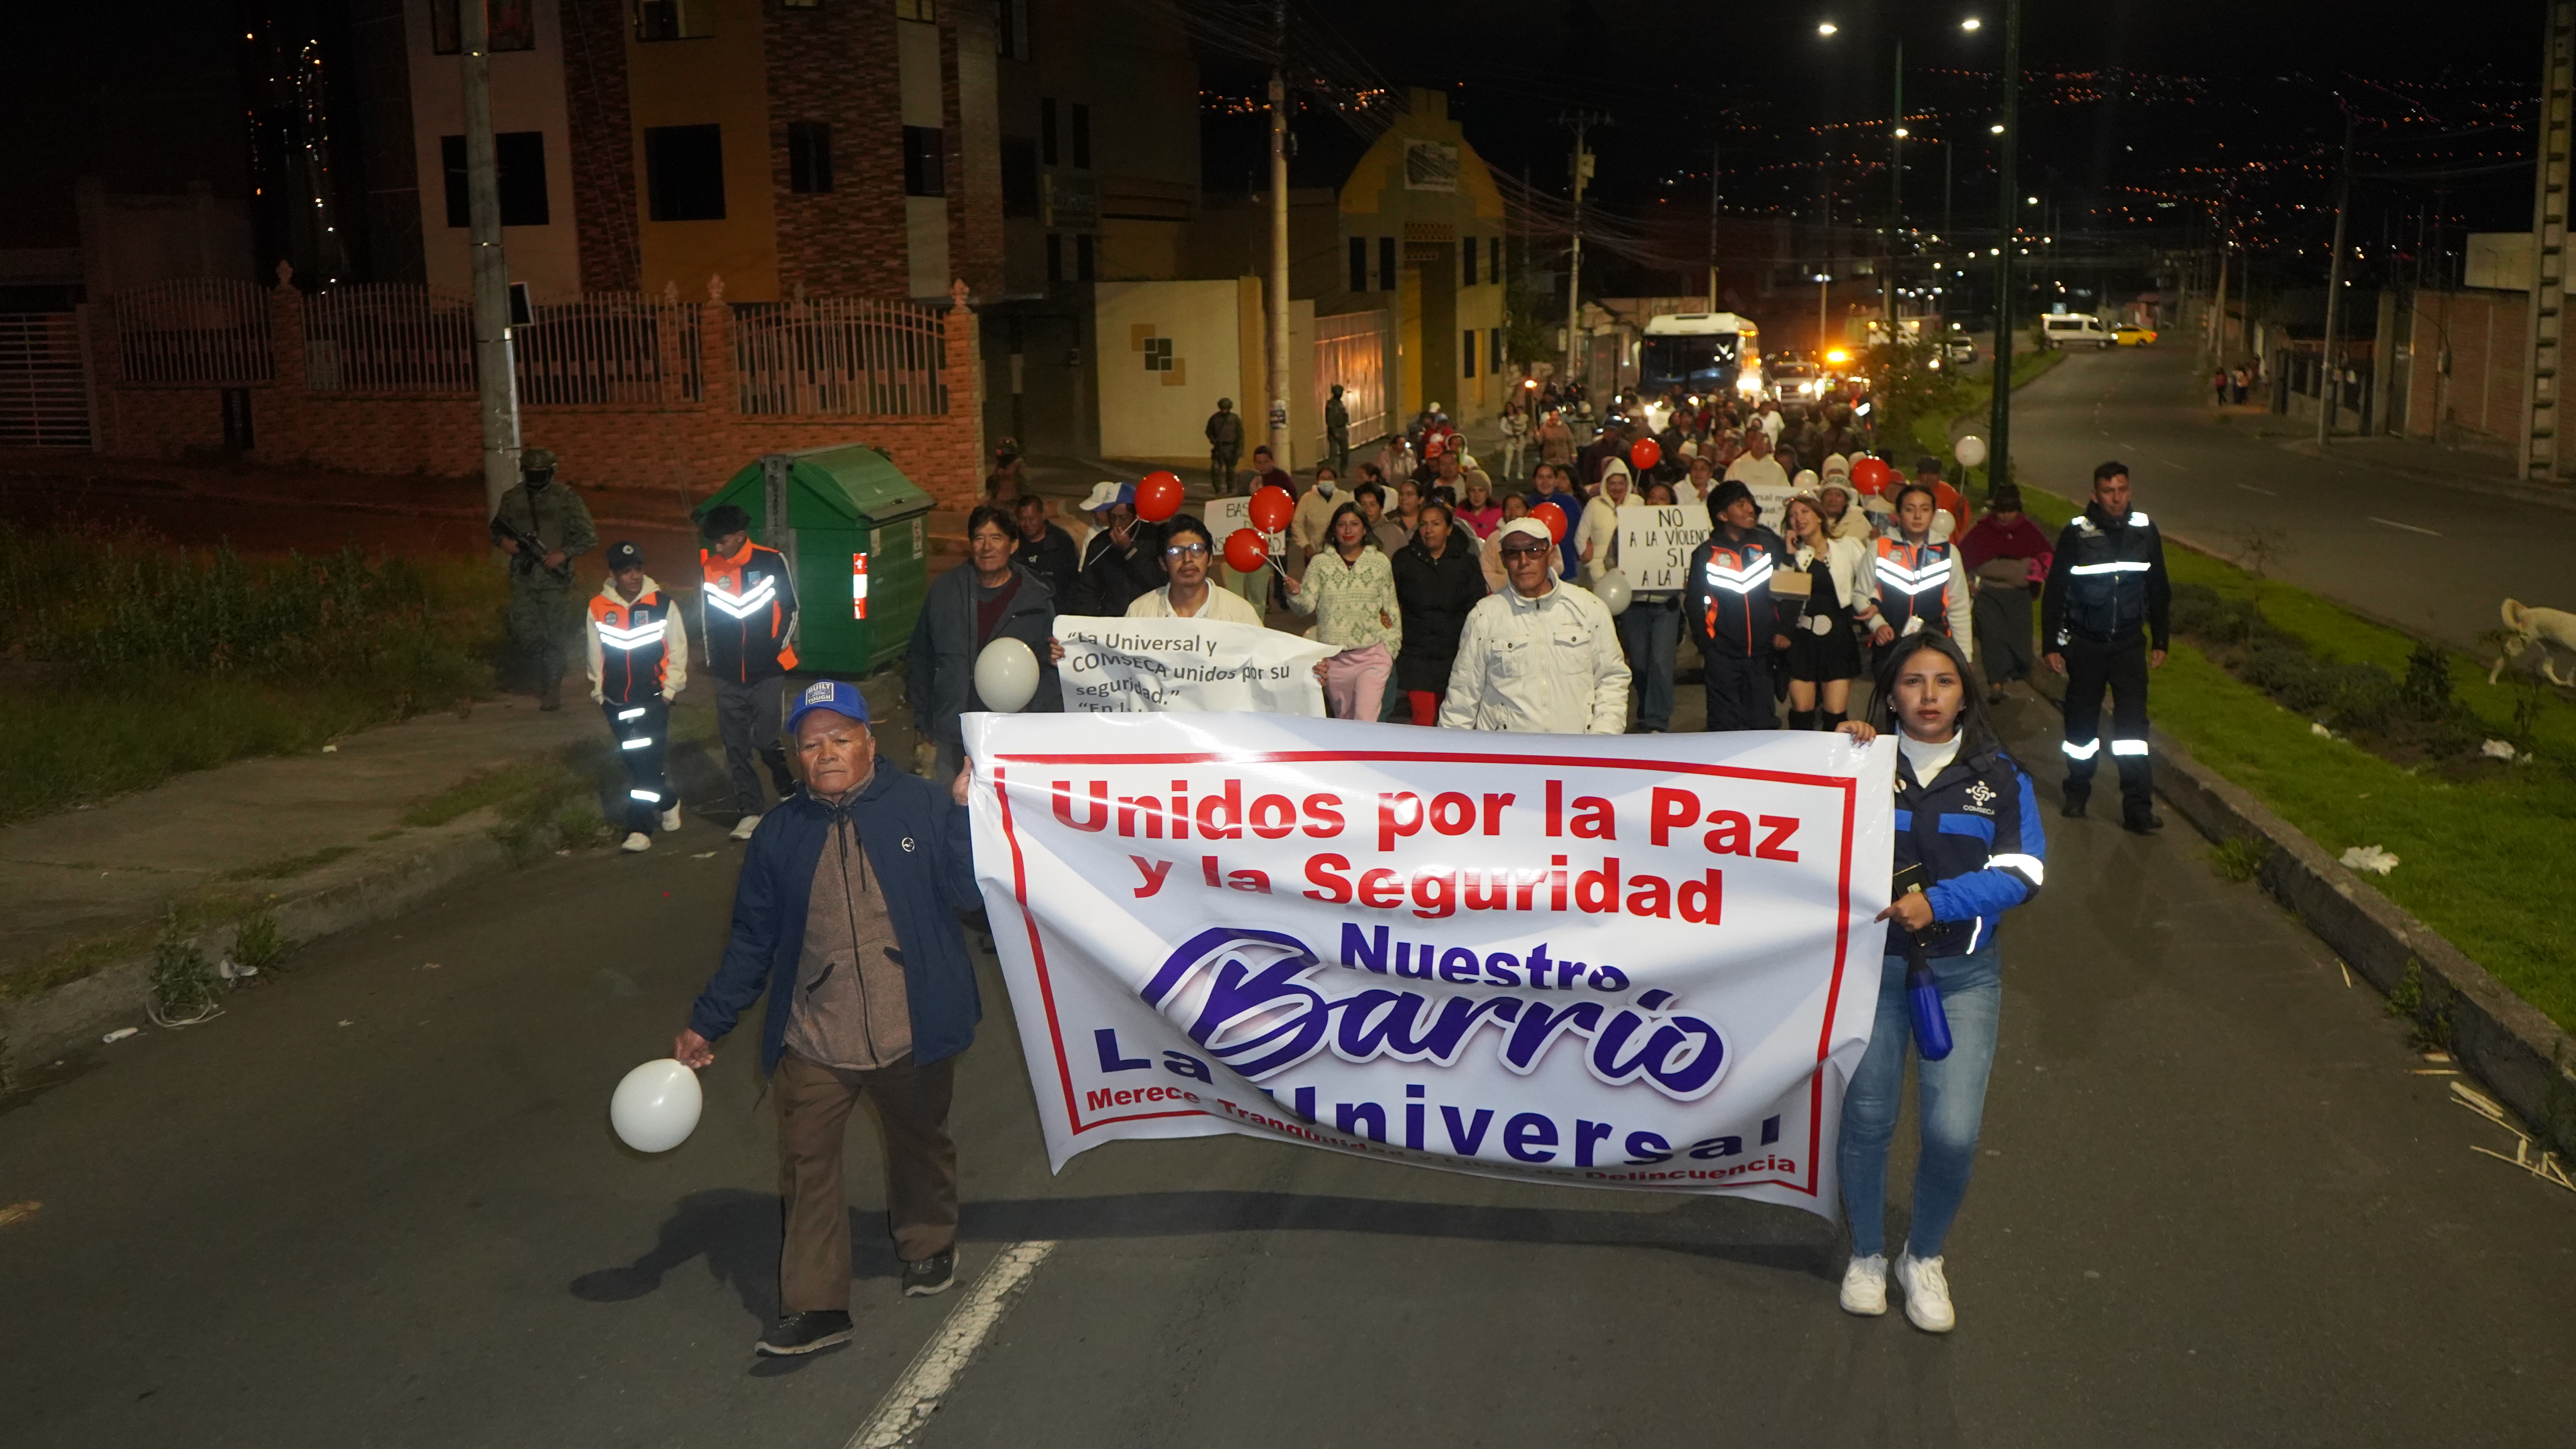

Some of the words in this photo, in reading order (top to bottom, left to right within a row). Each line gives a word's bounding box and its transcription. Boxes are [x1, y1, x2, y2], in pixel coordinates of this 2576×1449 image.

[1227, 503, 1249, 517] BAS
[1659, 509, 1683, 527] NO
[1630, 531, 1637, 547] A
[1646, 531, 1658, 546] LA
[1667, 548, 1684, 567] SI
[1642, 570, 1649, 586] A
[1658, 570, 1671, 585] LA
[1106, 634, 1200, 652] Universal
[1206, 641, 1217, 657] y
[1072, 652, 1167, 677] COMSECA
[1174, 665, 1237, 682] unidos
[1242, 666, 1264, 682] por
[1270, 666, 1289, 679] su
[808, 684, 831, 694] BUILT
[808, 694, 831, 703] TOUGH
[1052, 779, 1345, 840] Unidos
[1378, 791, 1516, 852] por
[1546, 779, 1617, 841] la
[1651, 787, 1800, 863] Paz
[1128, 855, 1173, 898] y
[1202, 855, 1273, 895] la
[1303, 852, 1722, 925] Seguridad
[1340, 922, 1631, 992] Nuestro
[1139, 927, 1724, 1093] Barrio
[1094, 1028, 1214, 1085] La
[1256, 1084, 1781, 1167] Universal
[1086, 1086, 1200, 1111] Merece
[1586, 1154, 1796, 1180] Delincuencia
